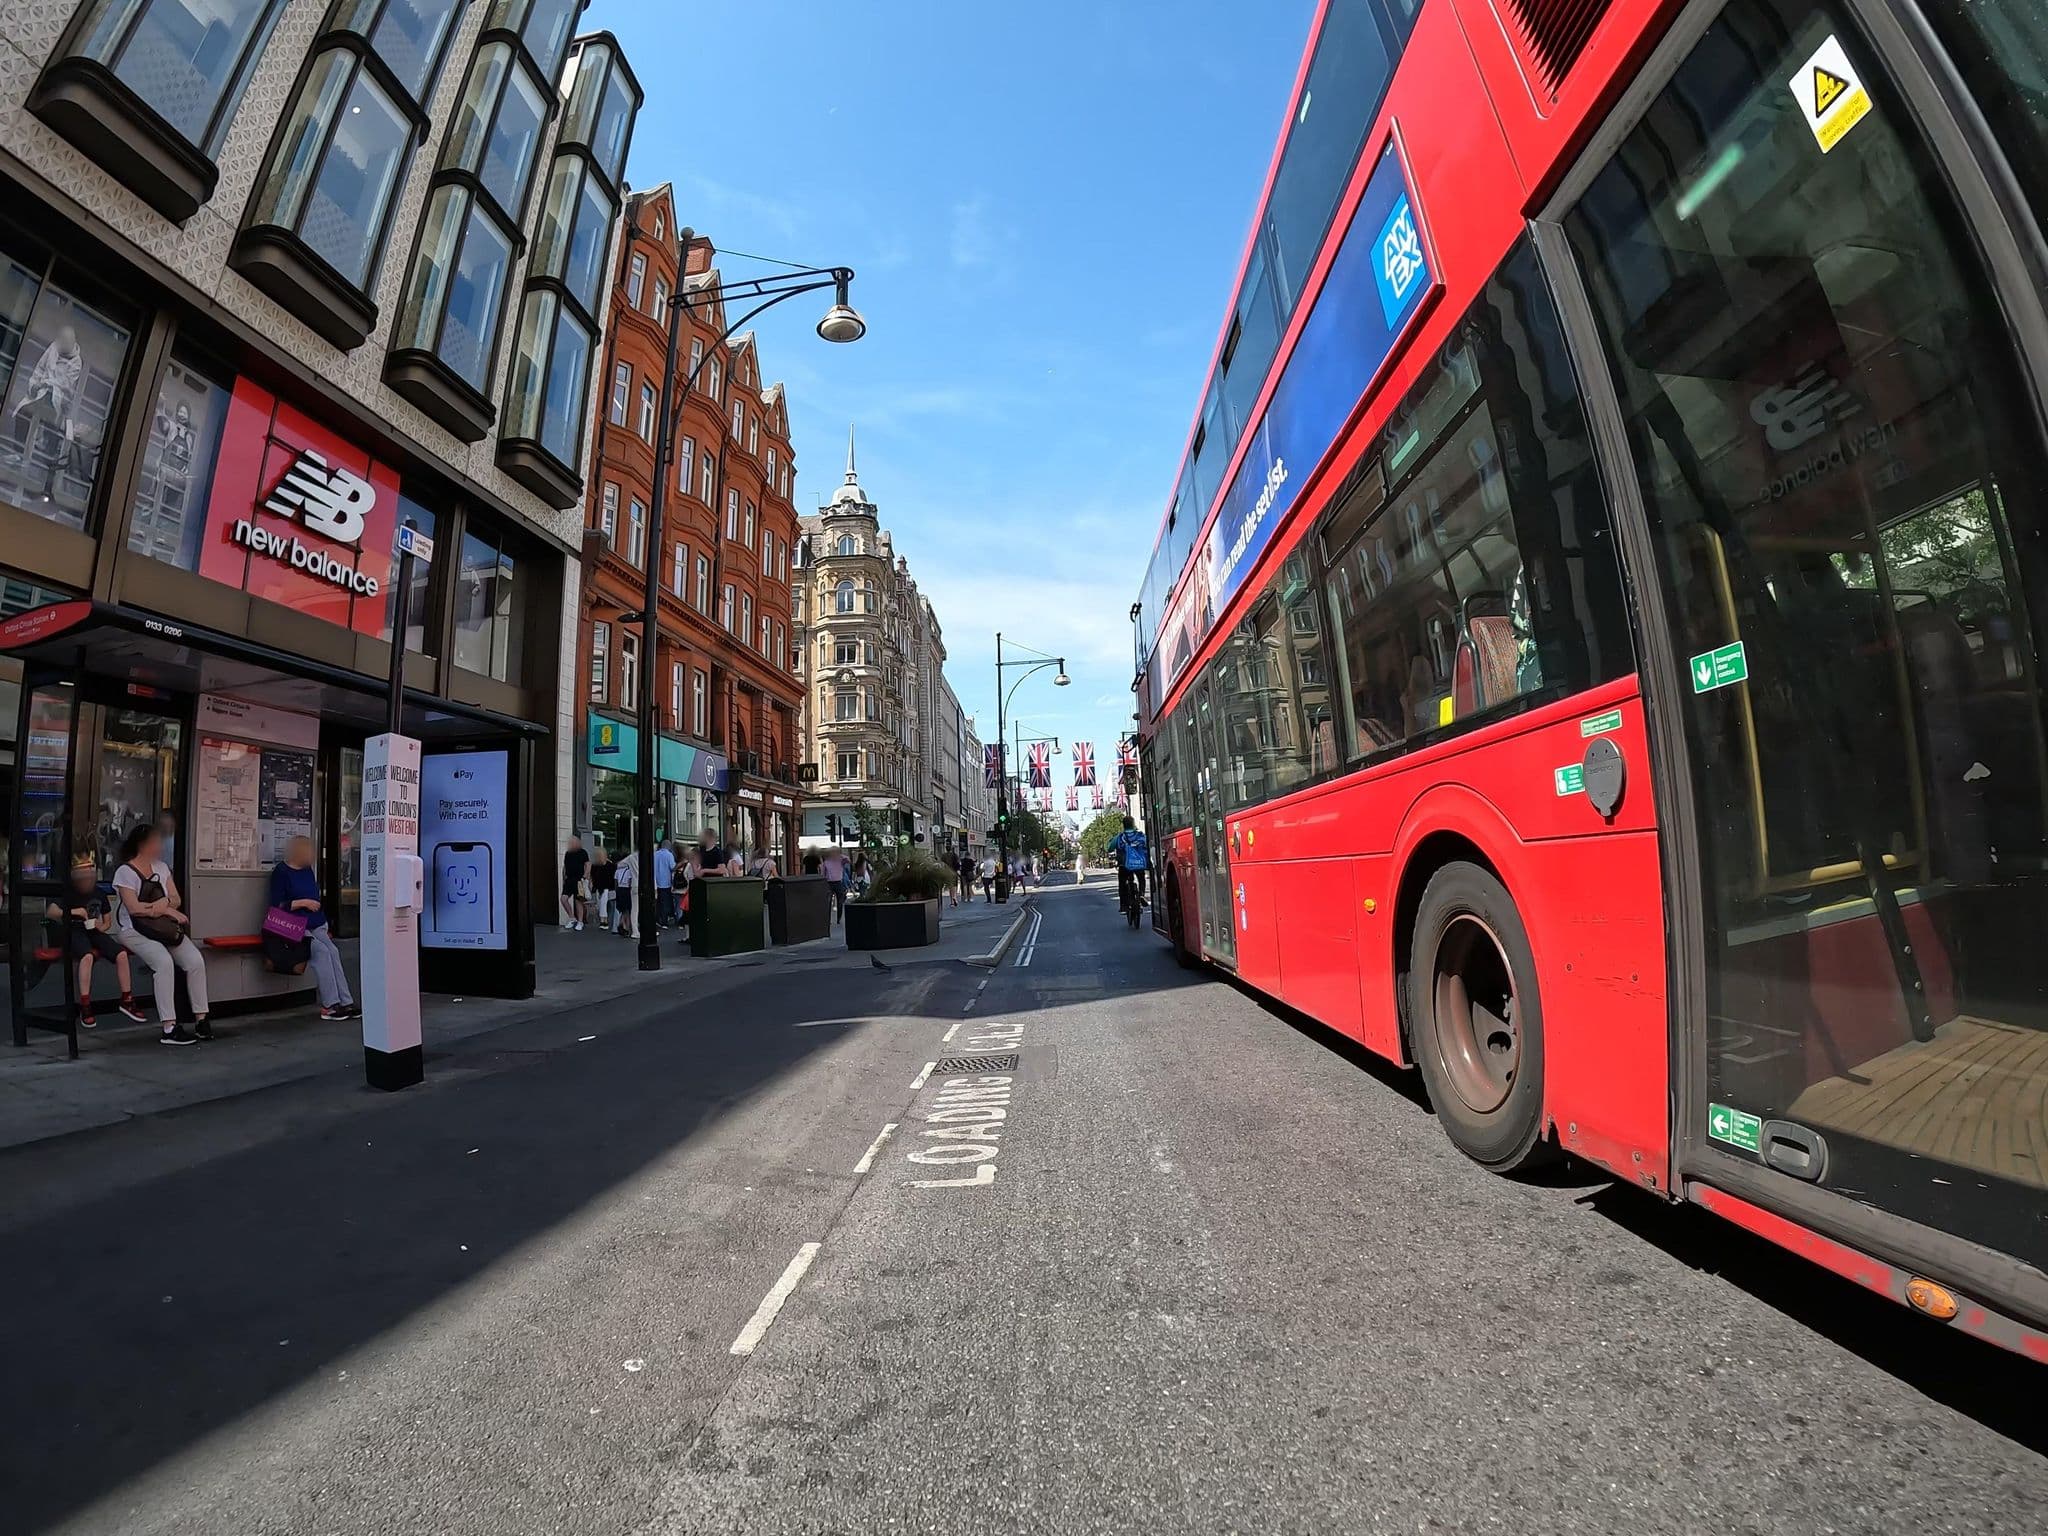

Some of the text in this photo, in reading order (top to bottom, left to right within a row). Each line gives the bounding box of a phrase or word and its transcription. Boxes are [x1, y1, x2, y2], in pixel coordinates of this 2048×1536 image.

[1230, 523, 1247, 569] read
[1244, 511, 1257, 544] the
[235, 518, 379, 598] new balance
[145, 620, 162, 631] 0133
[365, 765, 387, 783] WELCOME
[390, 765, 418, 785] WELCOME
[460, 770, 474, 780] Pay
[372, 784, 379, 799] TO
[400, 784, 408, 800] TO
[388, 800, 417, 819] LONDON'S
[439, 798, 489, 809] Pay securely.
[439, 811, 457, 820] With
[458, 811, 478, 820] Face
[364, 818, 385, 835] WEST END
[388, 818, 417, 836] WEST END
[901, 1076, 1013, 1188] LOADING
